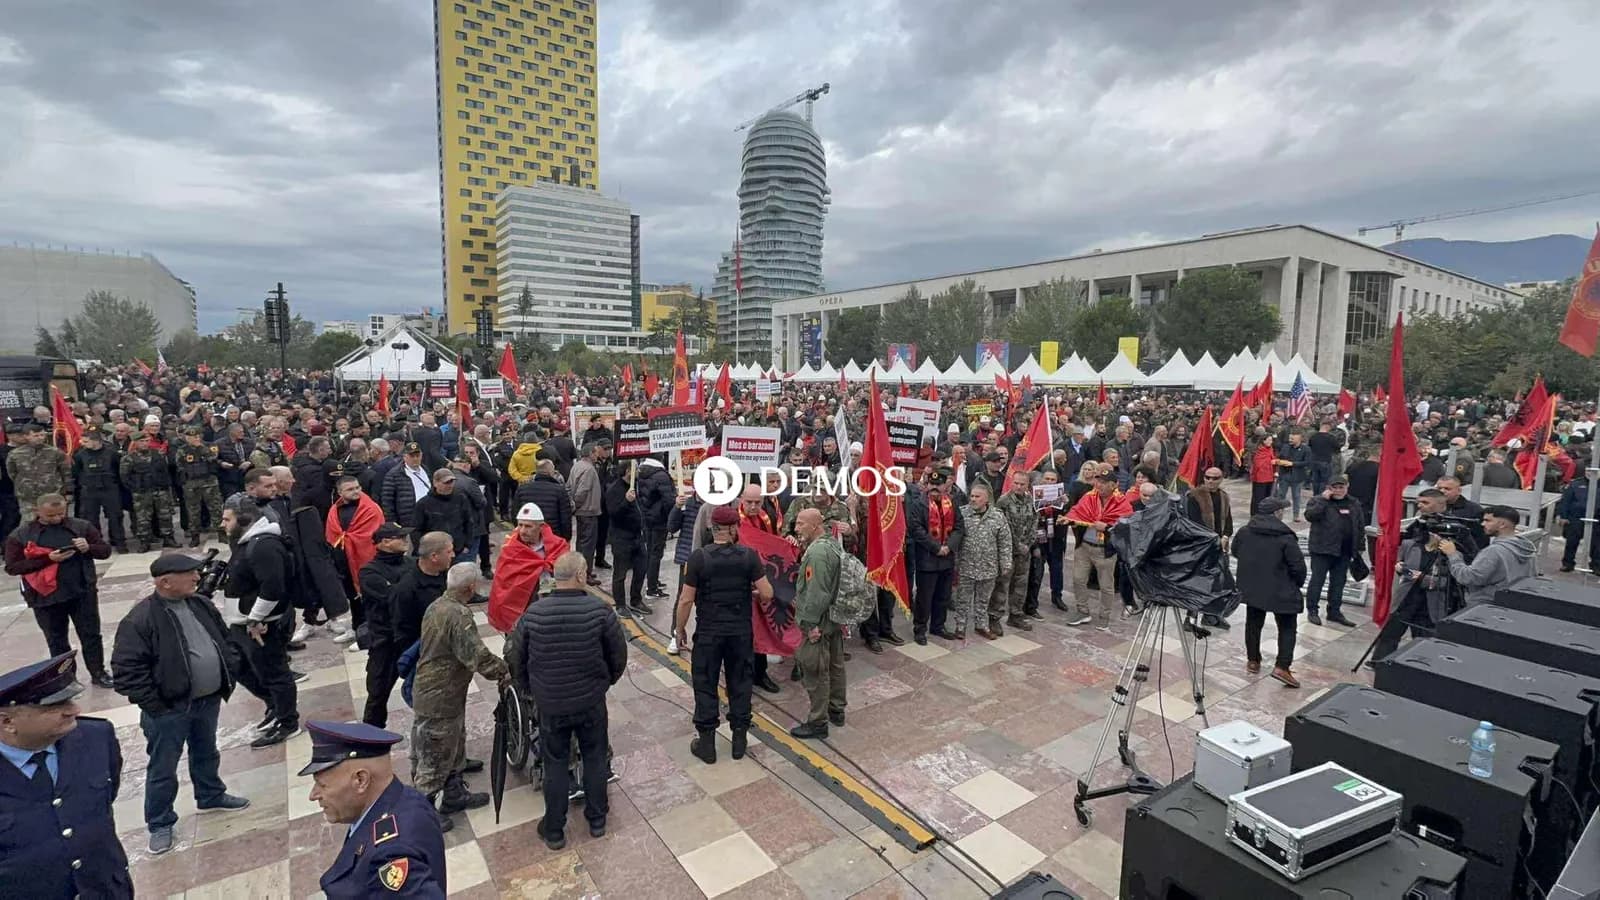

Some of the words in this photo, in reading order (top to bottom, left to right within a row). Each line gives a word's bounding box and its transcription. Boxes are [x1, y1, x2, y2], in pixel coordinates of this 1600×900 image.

[819, 296, 844, 305] OPERA
[728, 440, 742, 449] Mos
[747, 441, 774, 451] barazoni
